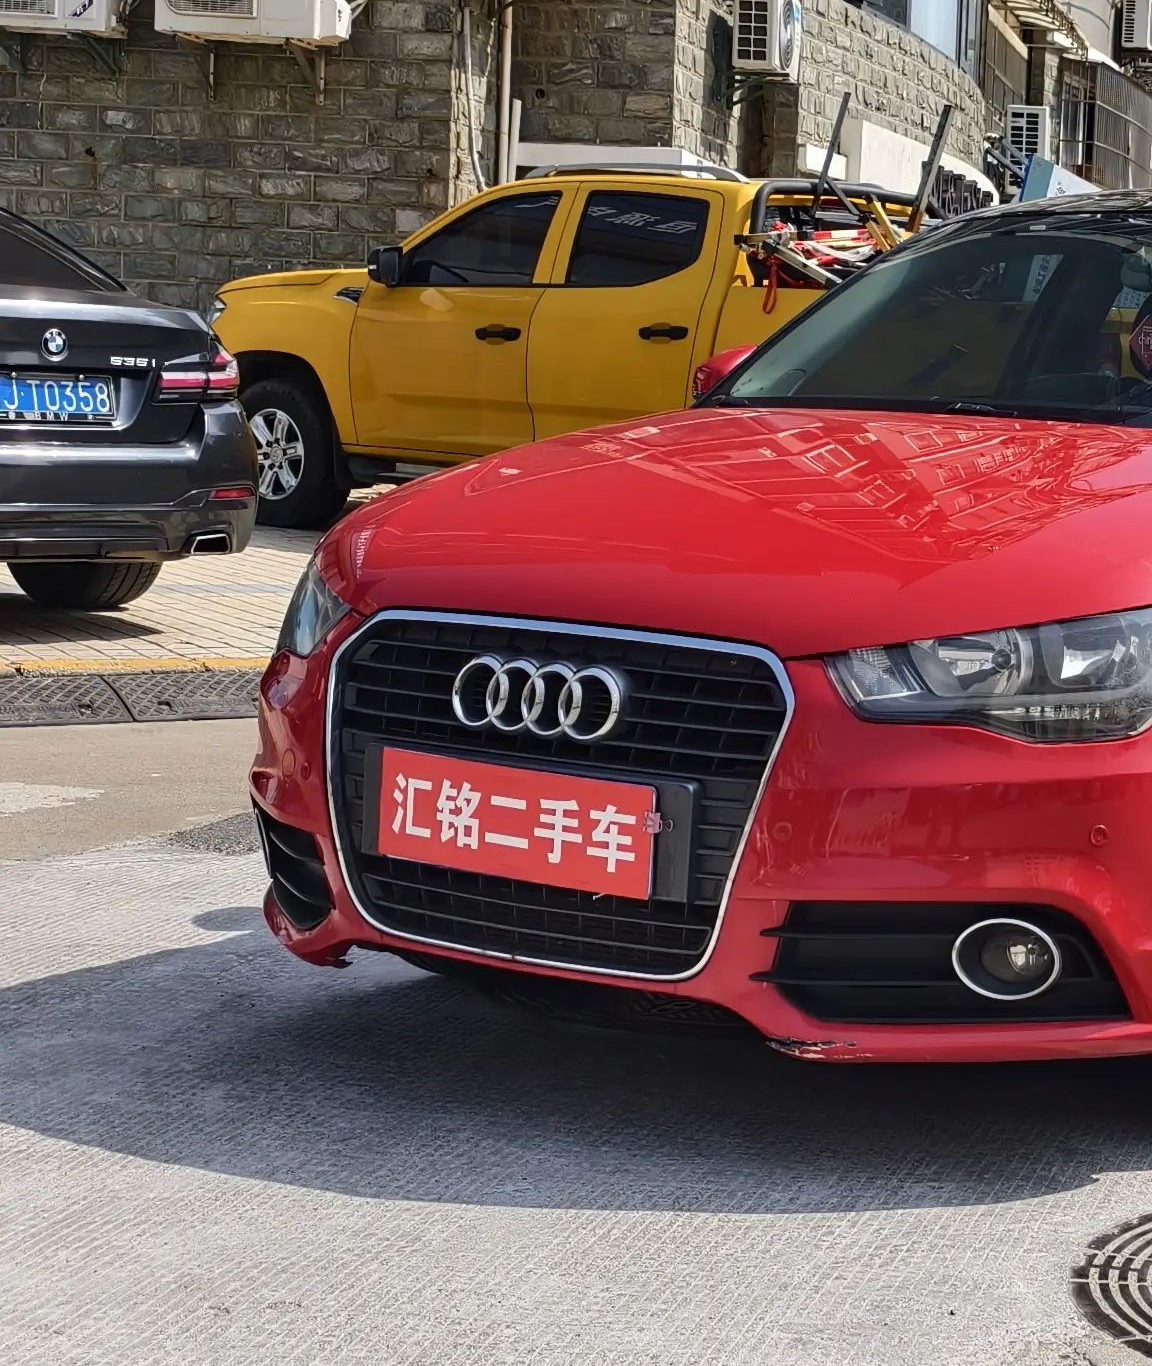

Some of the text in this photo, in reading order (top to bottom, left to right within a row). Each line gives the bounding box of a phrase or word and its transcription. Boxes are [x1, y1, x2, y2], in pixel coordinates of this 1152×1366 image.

[392, 773, 637, 873] 汇铭二手车
